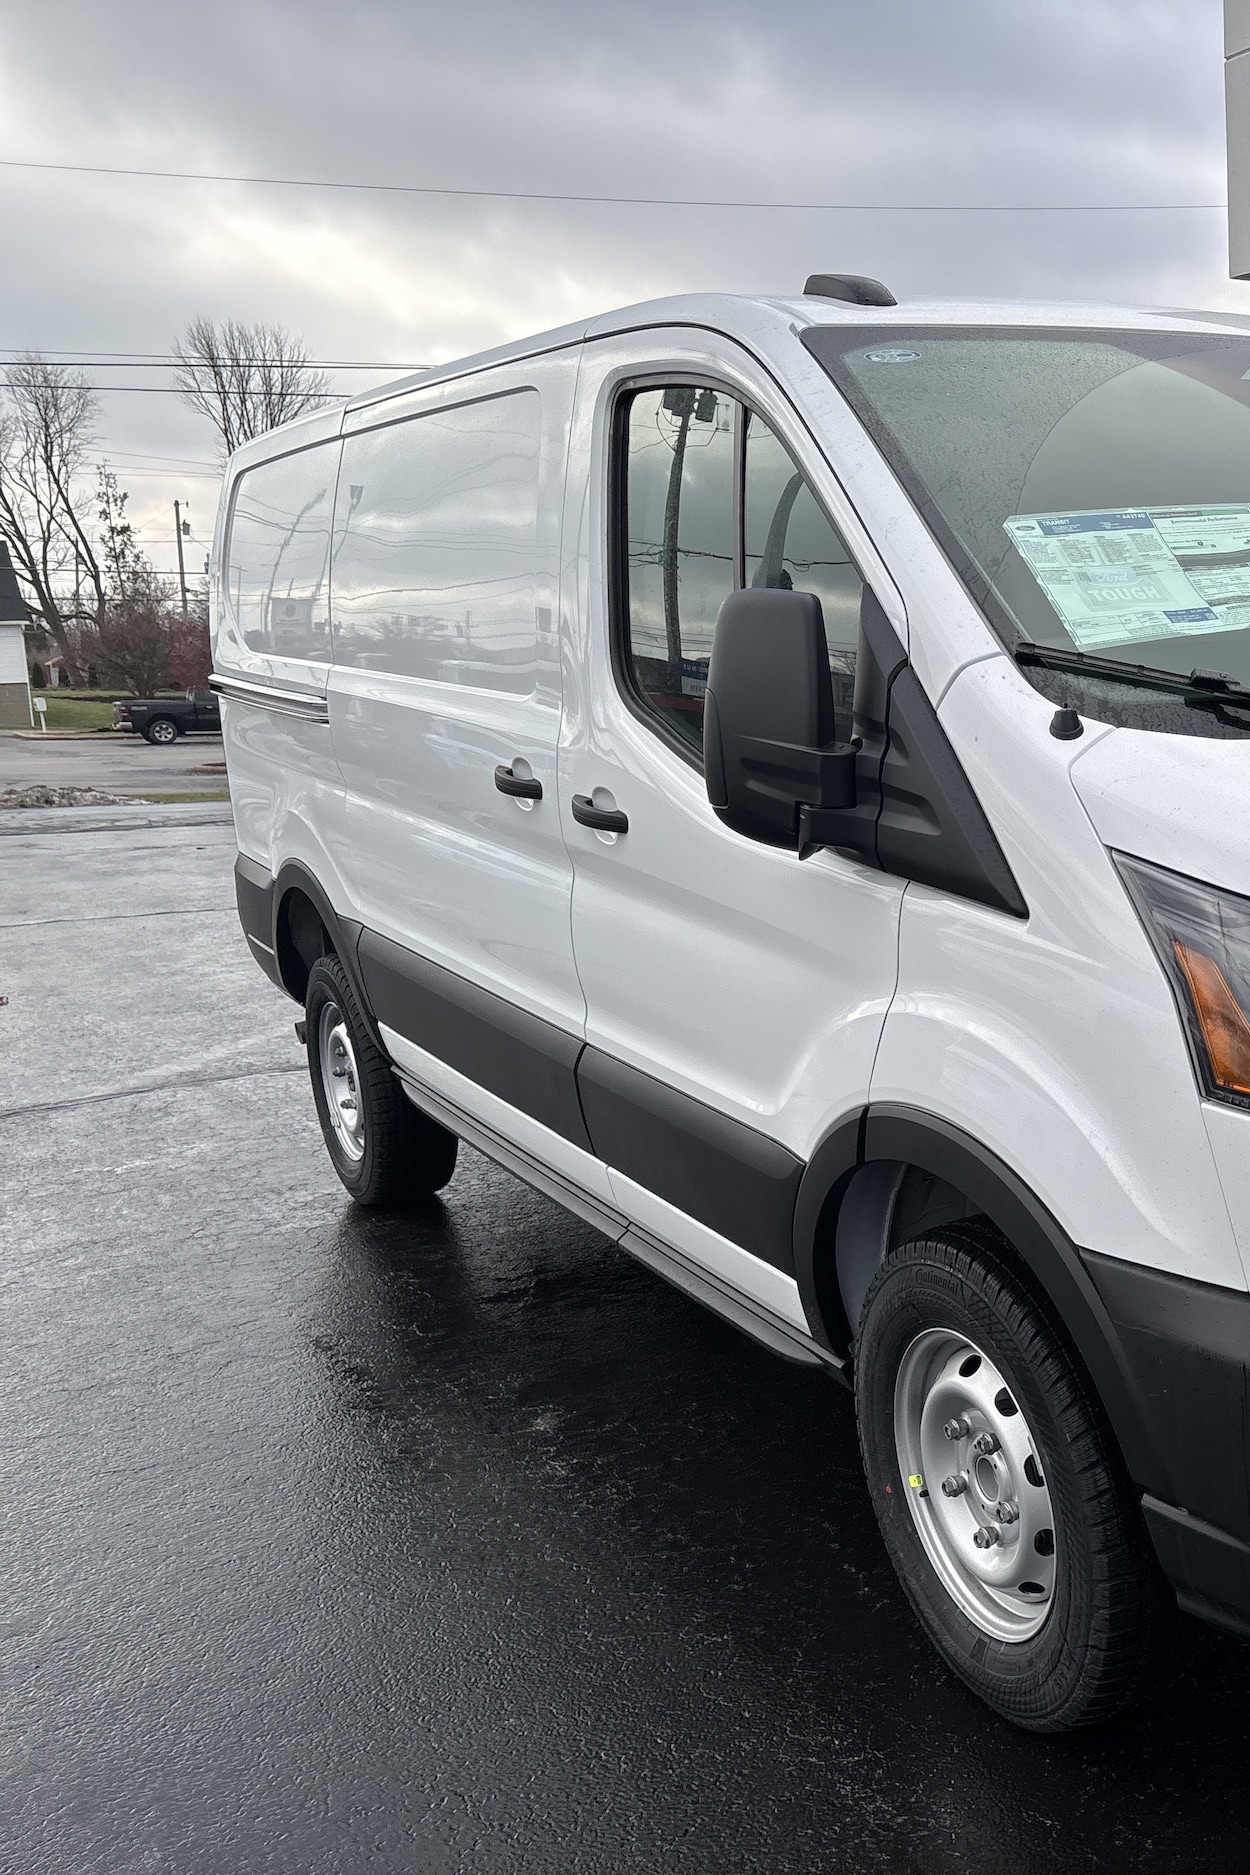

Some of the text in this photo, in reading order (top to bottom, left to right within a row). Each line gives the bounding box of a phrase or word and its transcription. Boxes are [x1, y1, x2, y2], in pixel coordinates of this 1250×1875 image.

[1041, 519, 1071, 527] TRANSIT
[1086, 585, 1162, 601] TOUGH
[915, 1268, 959, 1296] Continental
